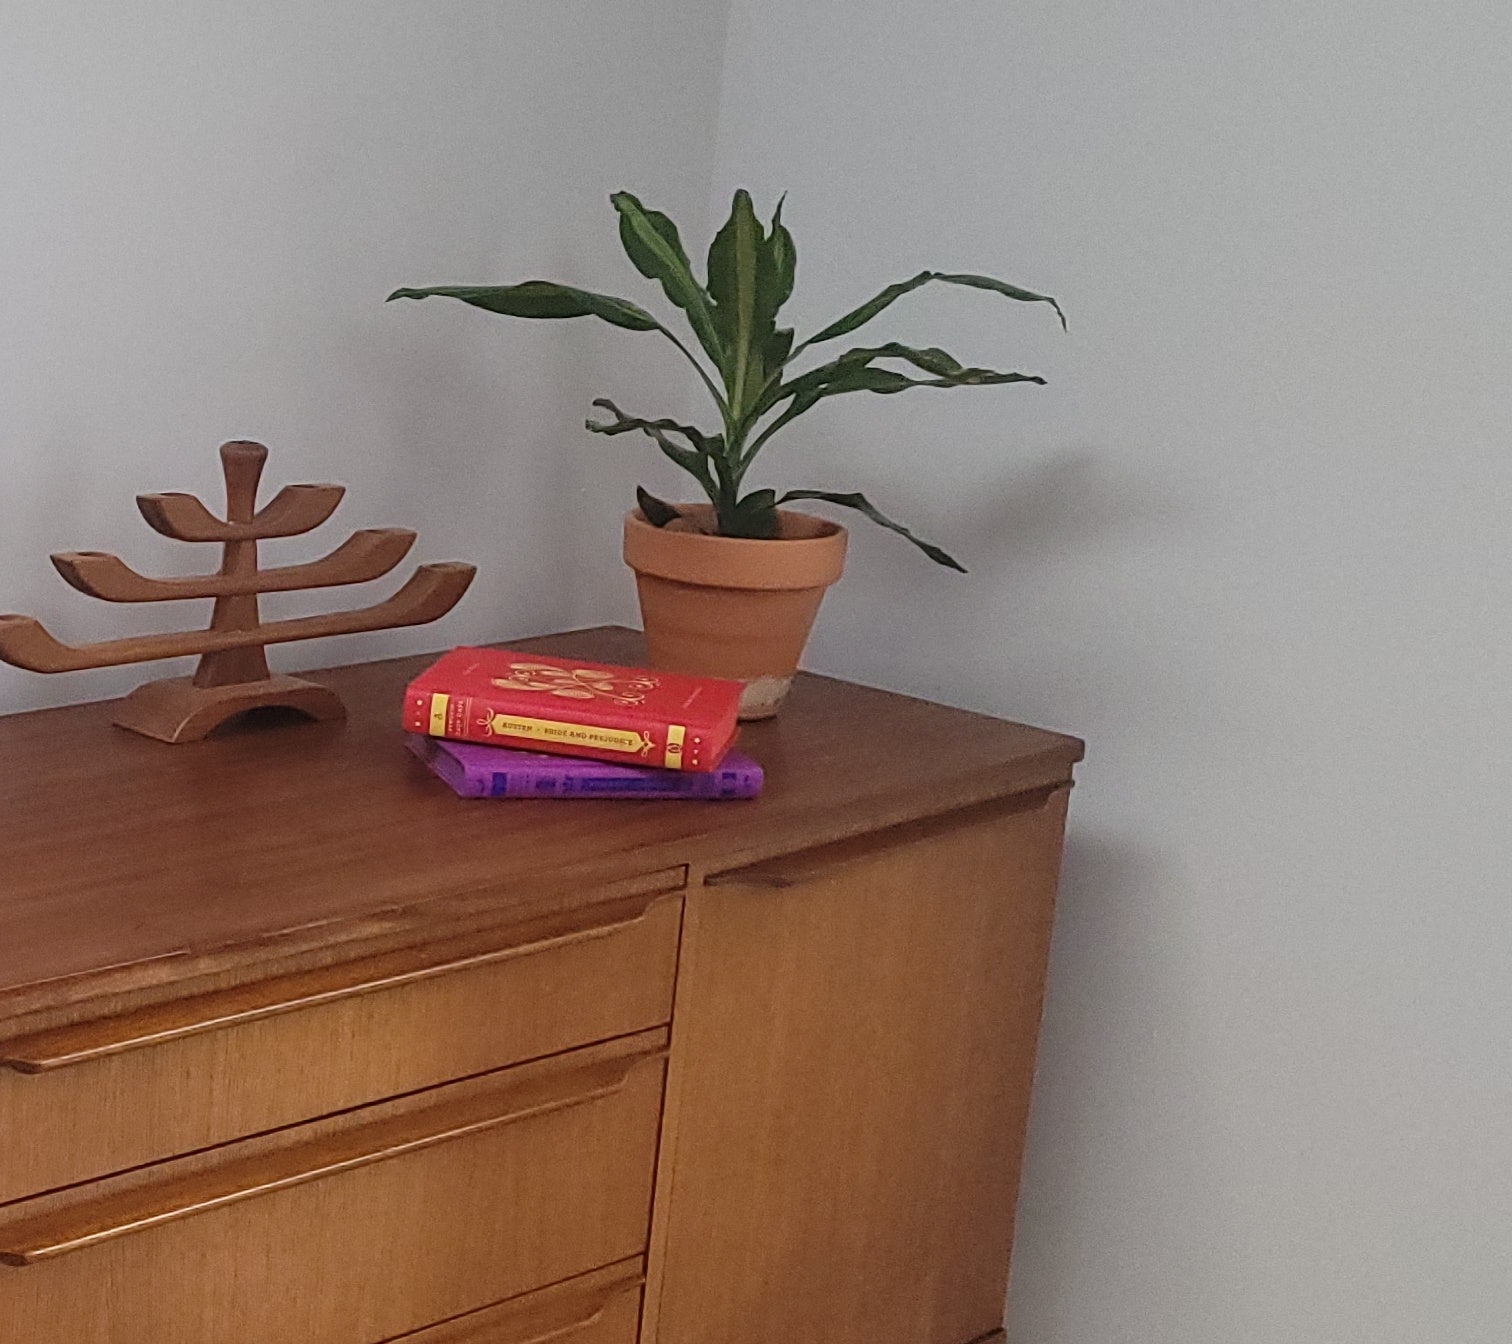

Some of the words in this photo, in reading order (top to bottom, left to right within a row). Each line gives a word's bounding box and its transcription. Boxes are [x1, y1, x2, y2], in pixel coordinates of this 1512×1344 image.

[502, 722, 533, 731] AUSTEN
[544, 728, 568, 737] PRIDE
[569, 731, 588, 740] AND
